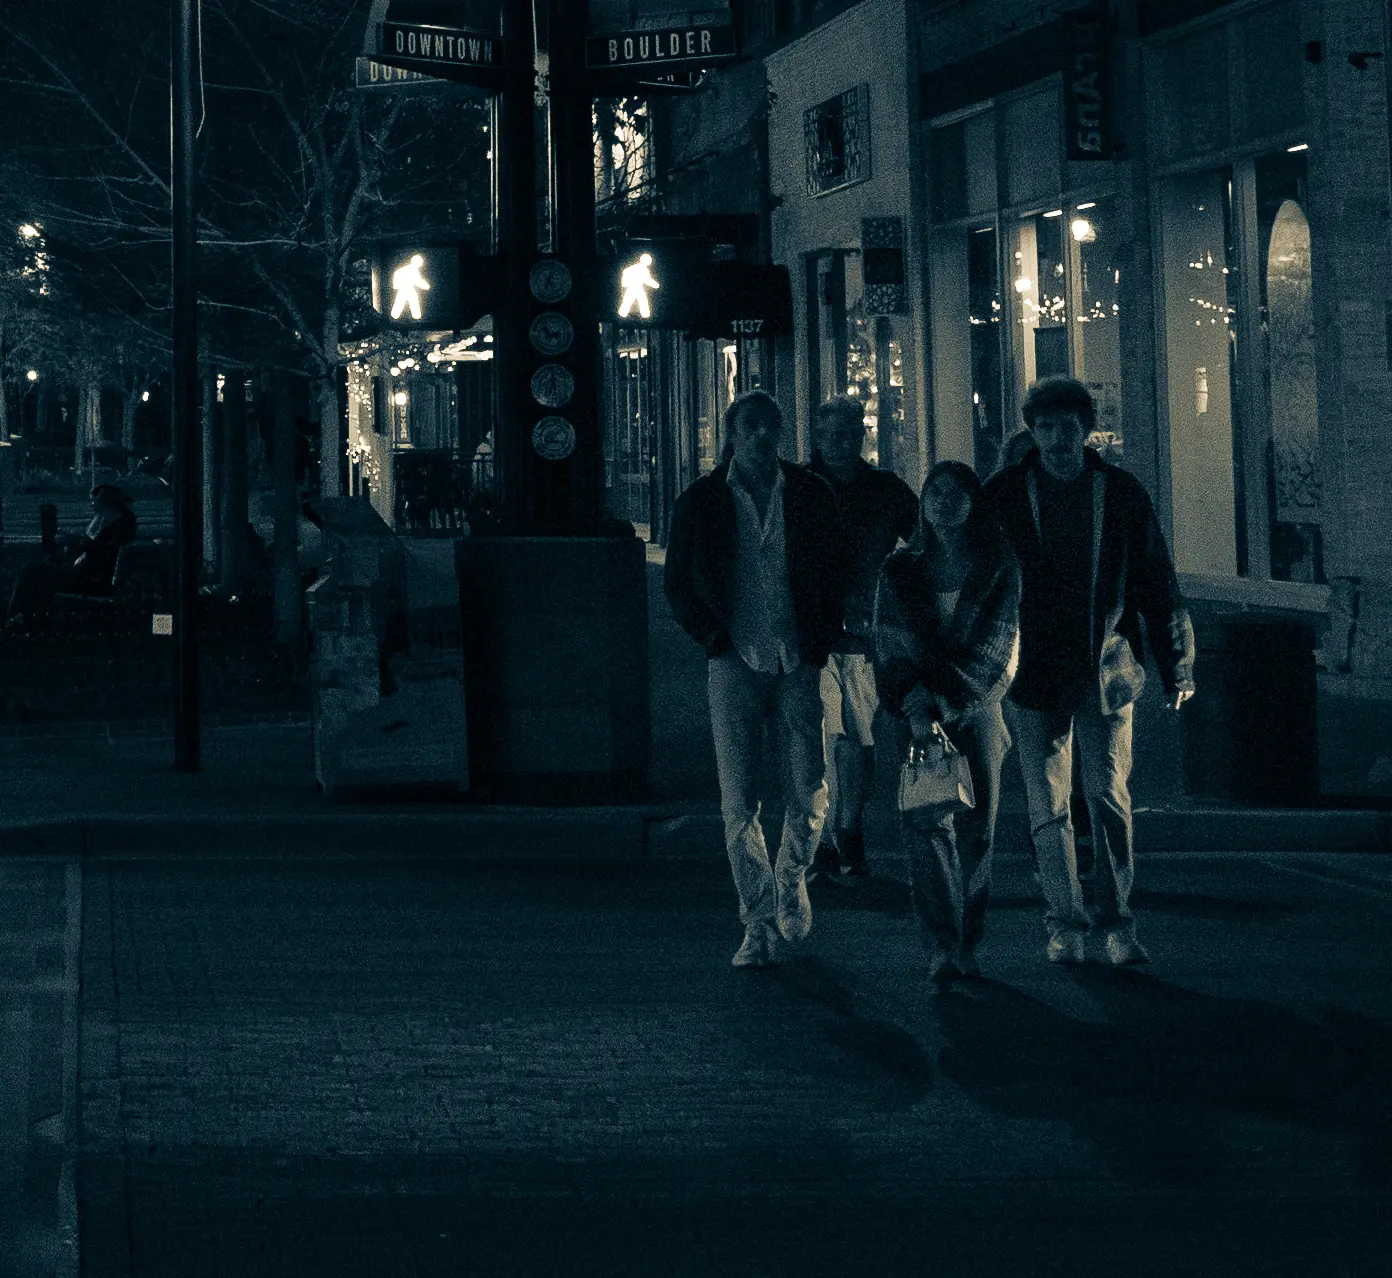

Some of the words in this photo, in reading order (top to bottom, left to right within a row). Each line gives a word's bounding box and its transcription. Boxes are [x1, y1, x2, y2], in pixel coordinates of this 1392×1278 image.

[395, 29, 493, 63] DOWNTOWN
[608, 29, 712, 62] BOULDER
[731, 319, 764, 333] 1137
